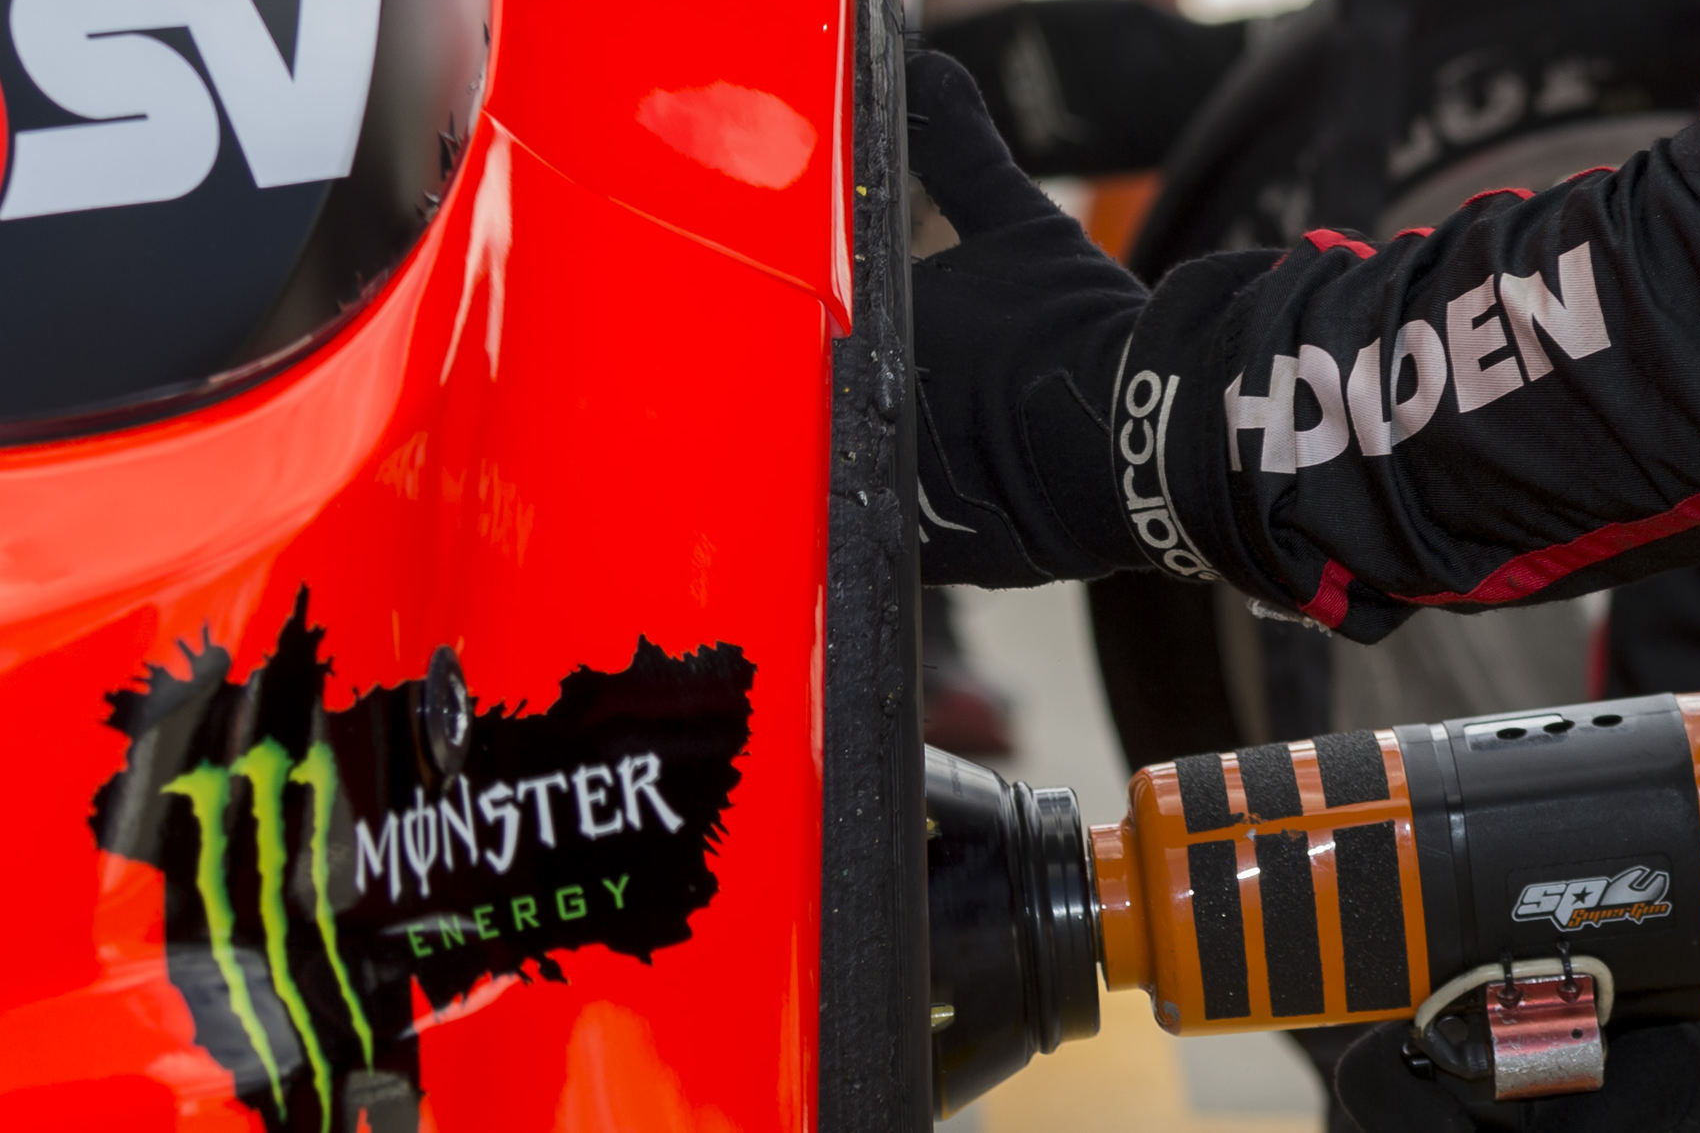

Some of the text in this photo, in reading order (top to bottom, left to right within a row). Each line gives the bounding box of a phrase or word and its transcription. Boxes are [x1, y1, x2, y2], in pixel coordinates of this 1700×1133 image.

[1119, 369, 1218, 580] parco
[354, 752, 684, 902] MONSTER
[407, 874, 631, 959] ENERGY
